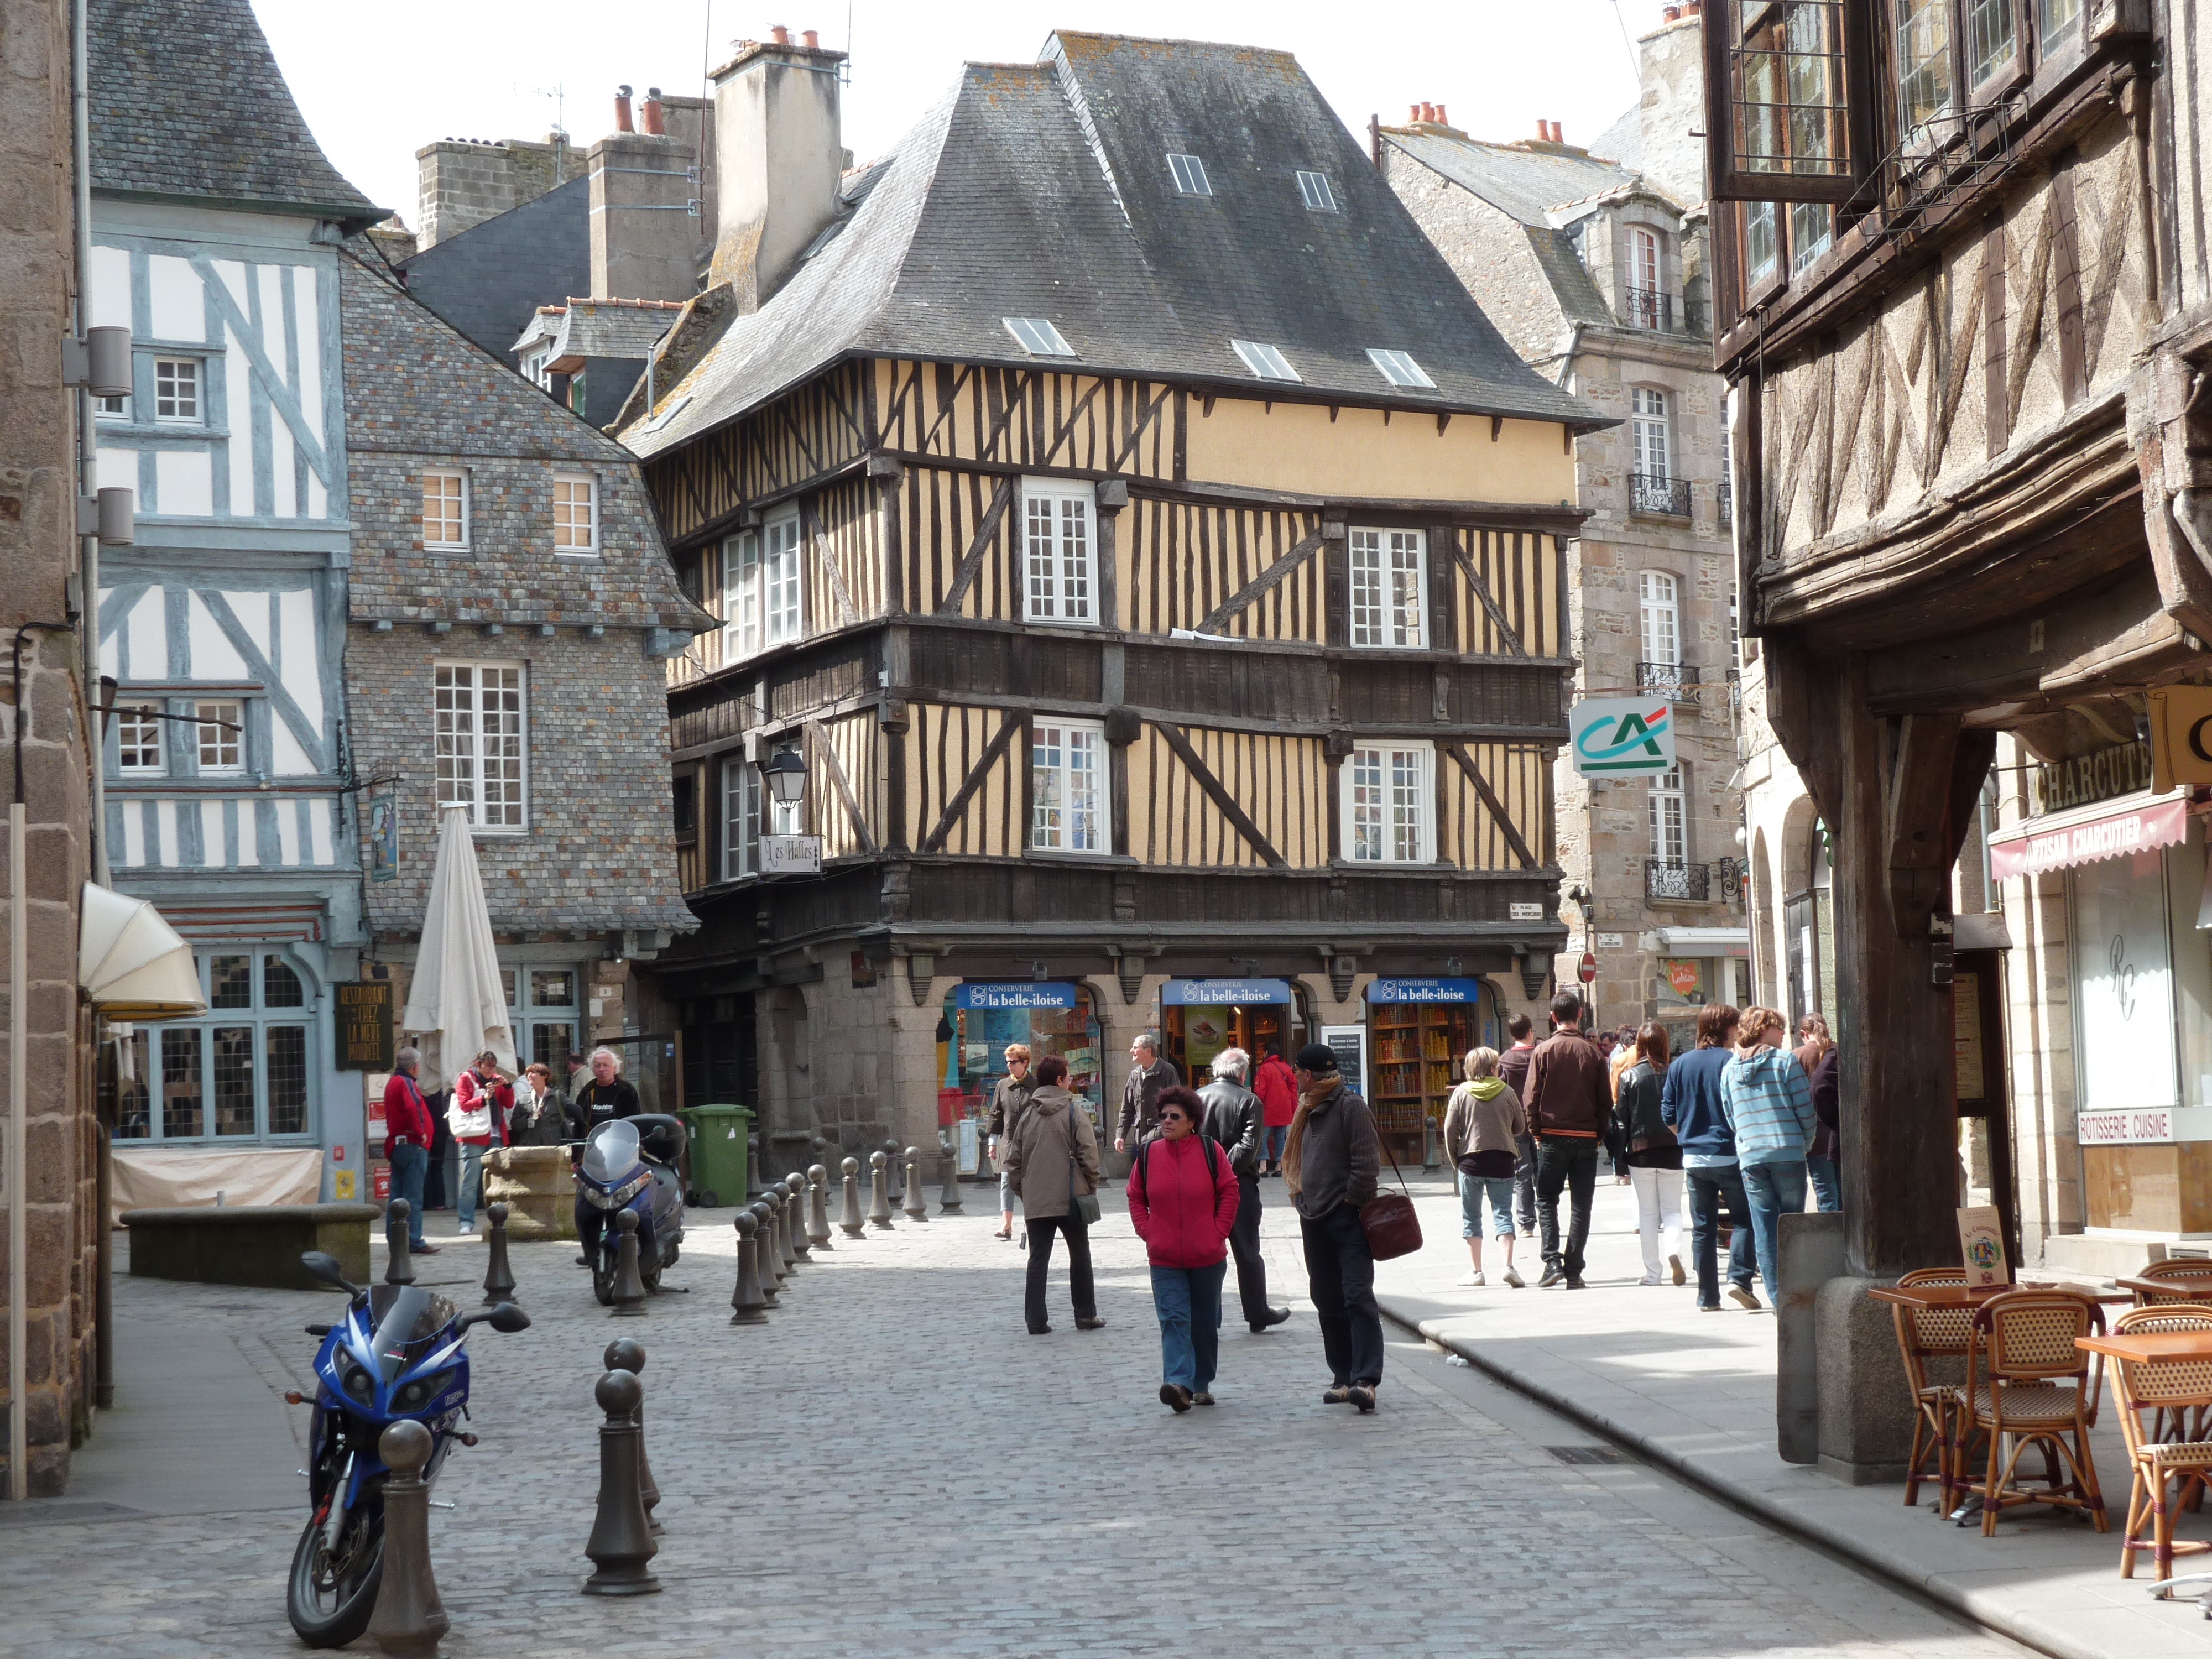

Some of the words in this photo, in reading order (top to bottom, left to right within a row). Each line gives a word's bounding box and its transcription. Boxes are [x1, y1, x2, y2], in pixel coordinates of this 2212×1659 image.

[2023, 833, 2068, 868] ARTISAN
[2073, 815, 2141, 857] CHARCUTIER
[765, 841, 784, 867] Les
[786, 841, 812, 860] Halles
[341, 986, 388, 1004] RESTAURANT
[989, 994, 999, 1006] la
[1001, 993, 1063, 1006] belle-iloise
[1200, 989, 1209, 1001] la
[1212, 989, 1270, 1001] belle-iloise
[1398, 988, 1407, 1000] la
[1409, 988, 1464, 1000] belle-iloise
[359, 1005, 378, 1023] CHEZ
[347, 1024, 357, 1042] LA
[2080, 1115, 2127, 1140] ROTISSERIE
[2133, 1113, 2168, 1139] CUISINE
